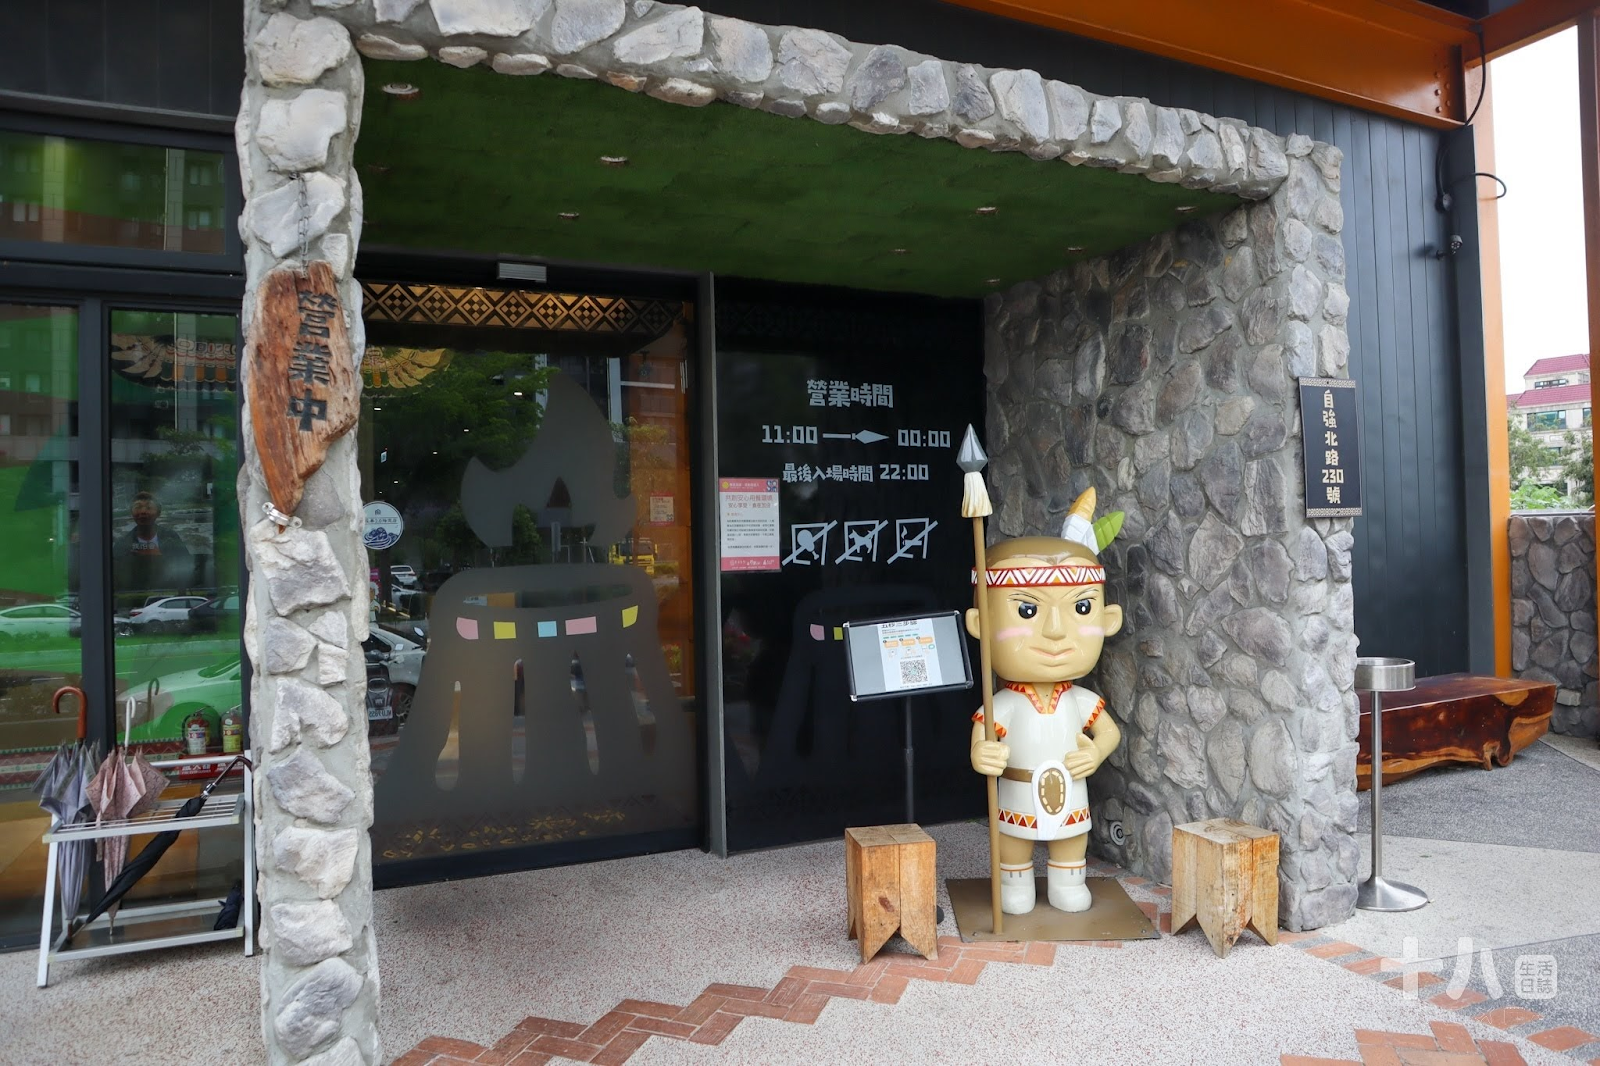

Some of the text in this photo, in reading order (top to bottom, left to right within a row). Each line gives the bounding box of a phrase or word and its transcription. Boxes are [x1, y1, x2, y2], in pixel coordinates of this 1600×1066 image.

[287, 290, 337, 432] 營業中
[807, 379, 894, 408] 營業時間
[762, 425, 951, 448] 11:00 00:00
[1321, 389, 1345, 504] 自強北路230號
[782, 462, 929, 483] 最後入場時間 22:00
